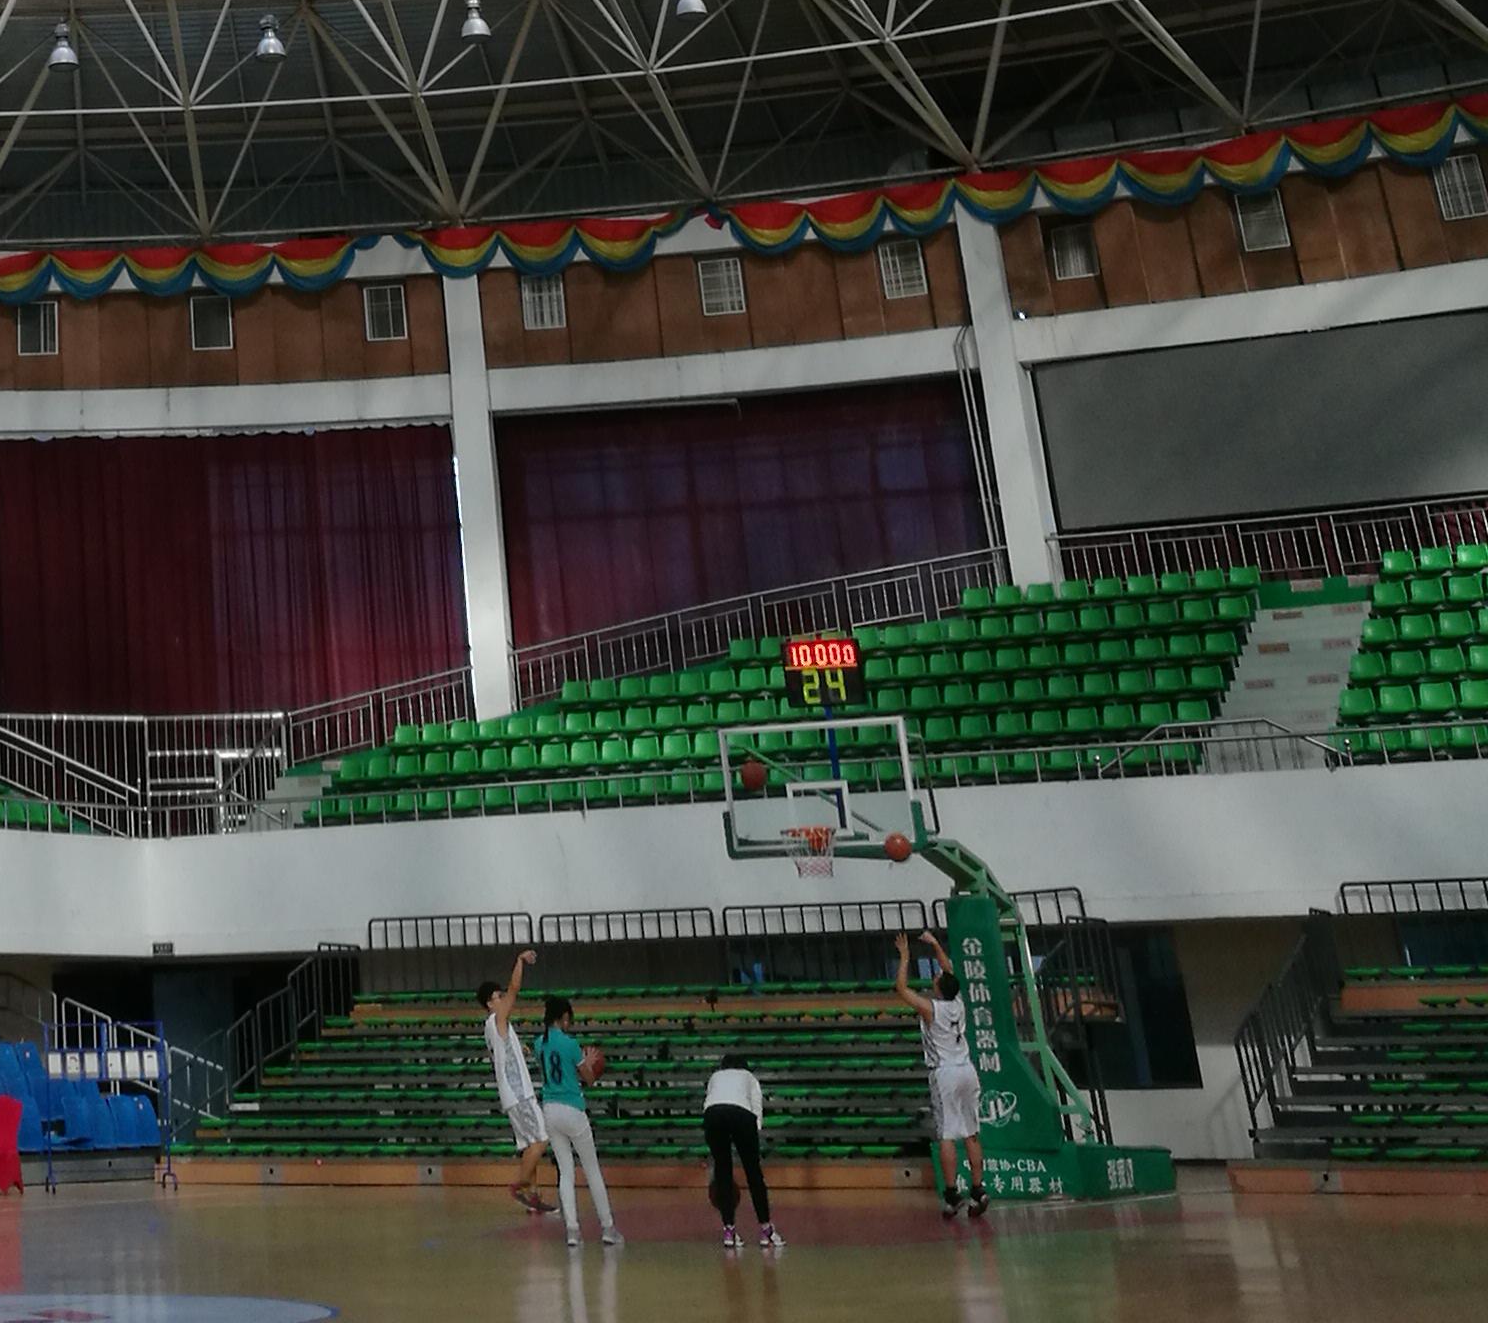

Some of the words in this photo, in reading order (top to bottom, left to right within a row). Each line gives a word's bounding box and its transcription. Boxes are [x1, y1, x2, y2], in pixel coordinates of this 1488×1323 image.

[801, 668, 846, 704] 24
[962, 937, 1001, 1073] 金陵体育器材
